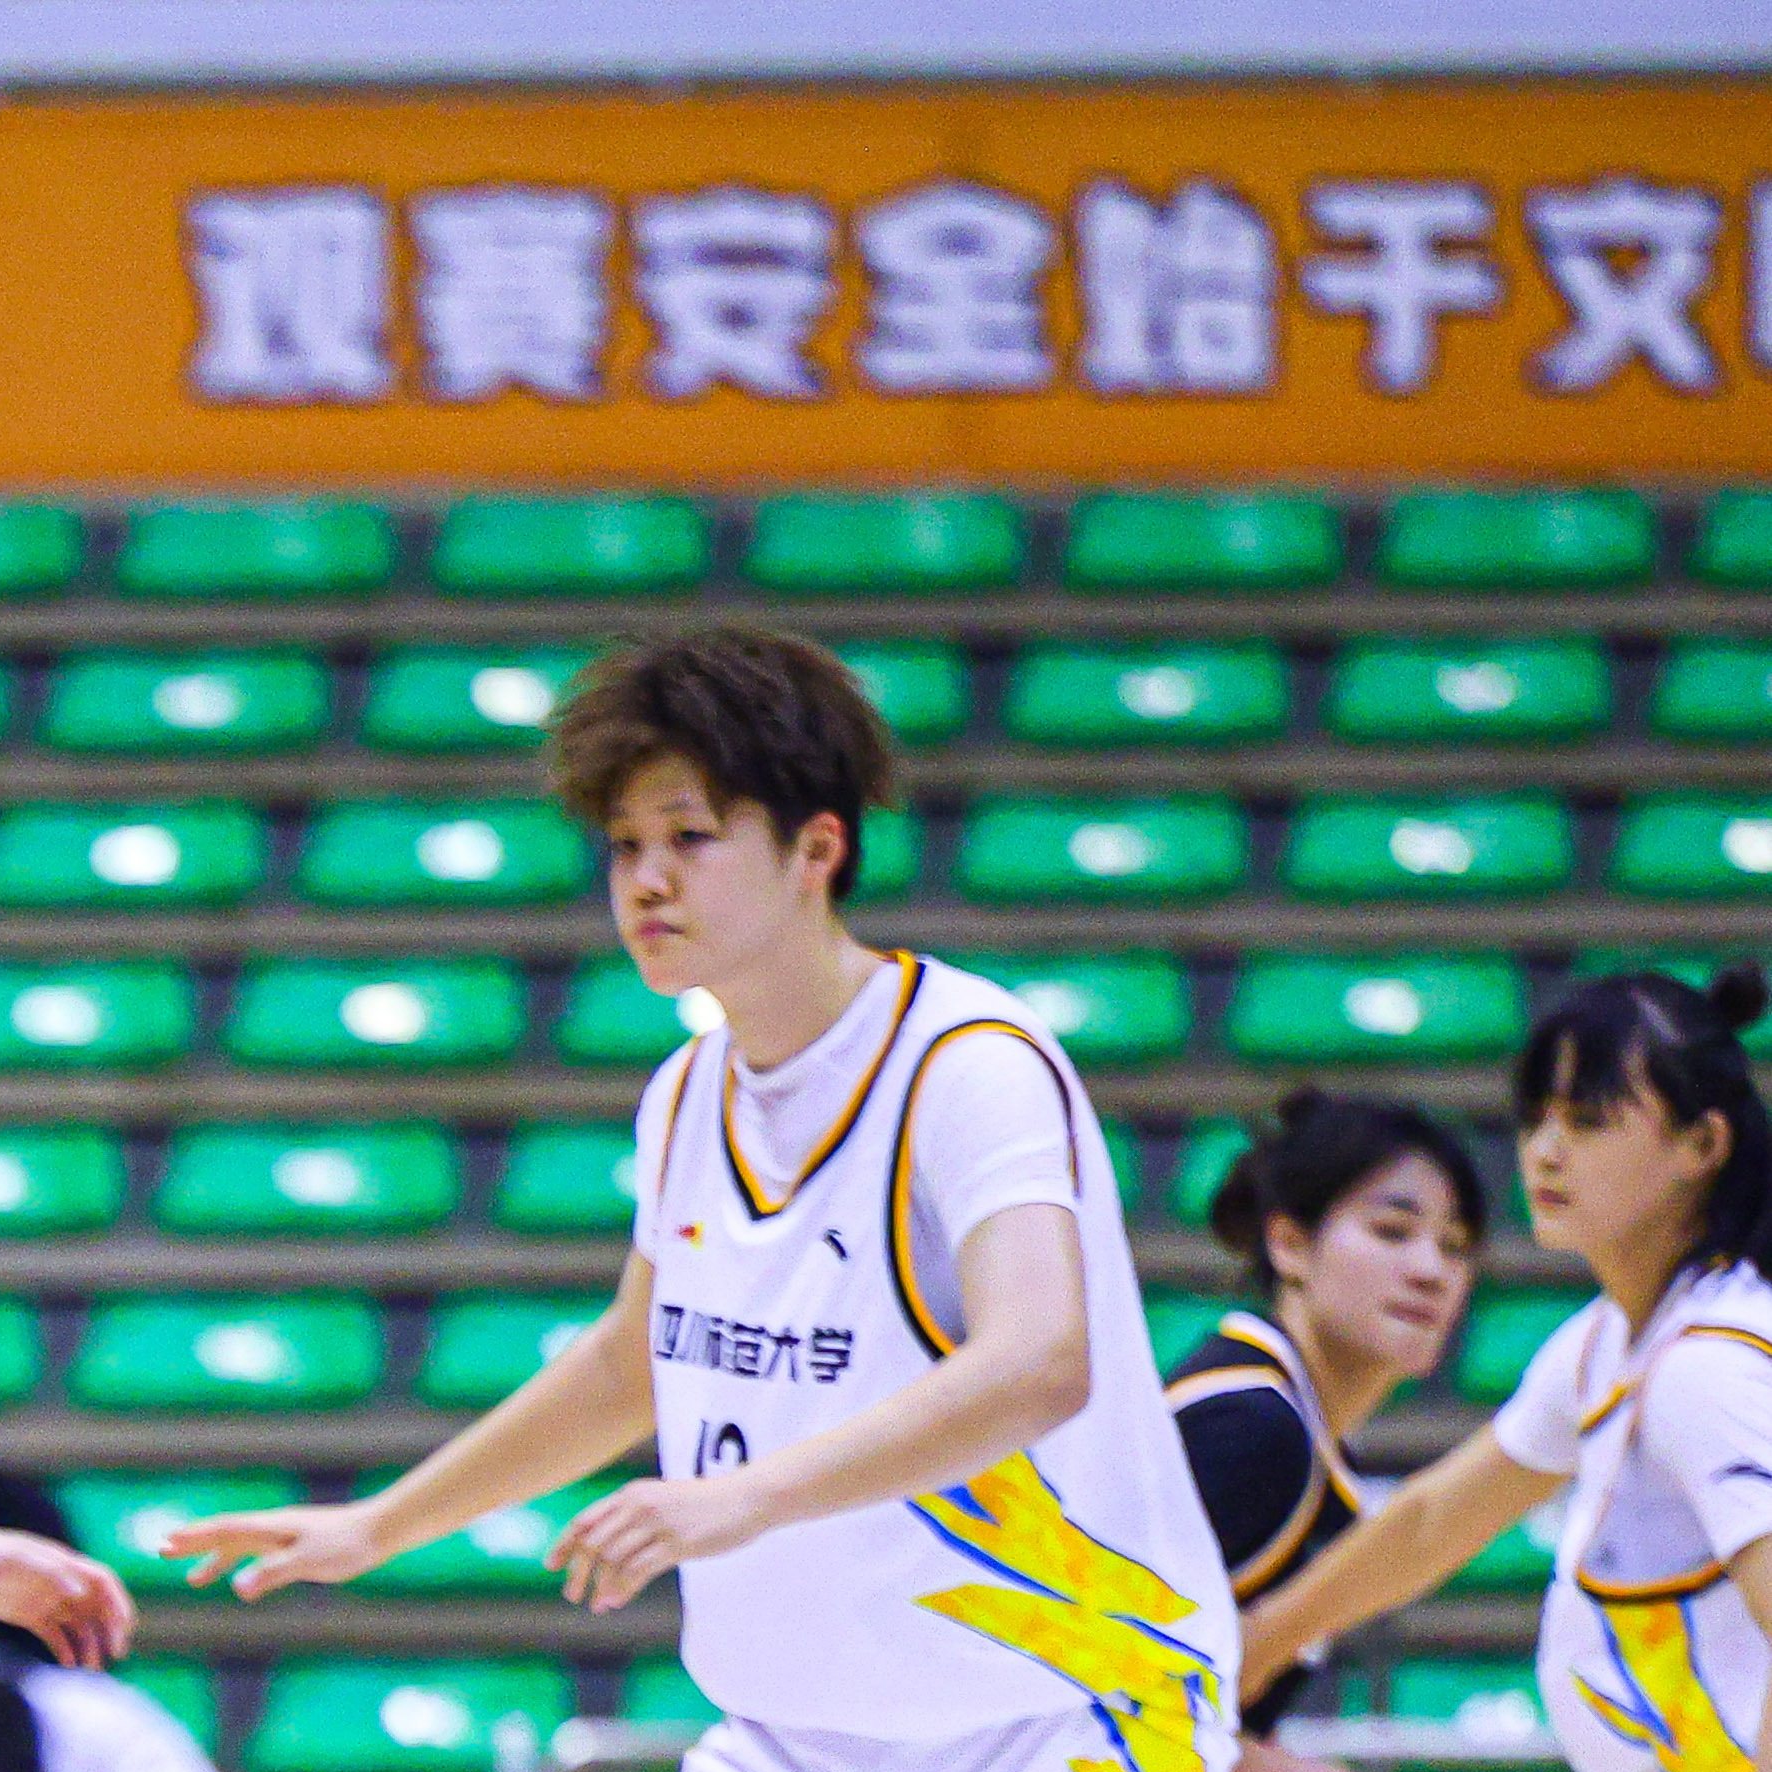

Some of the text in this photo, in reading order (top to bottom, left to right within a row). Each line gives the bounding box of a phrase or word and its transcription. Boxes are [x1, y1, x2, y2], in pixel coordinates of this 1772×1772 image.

[183, 174, 1772, 402] 观赛安全始于文
